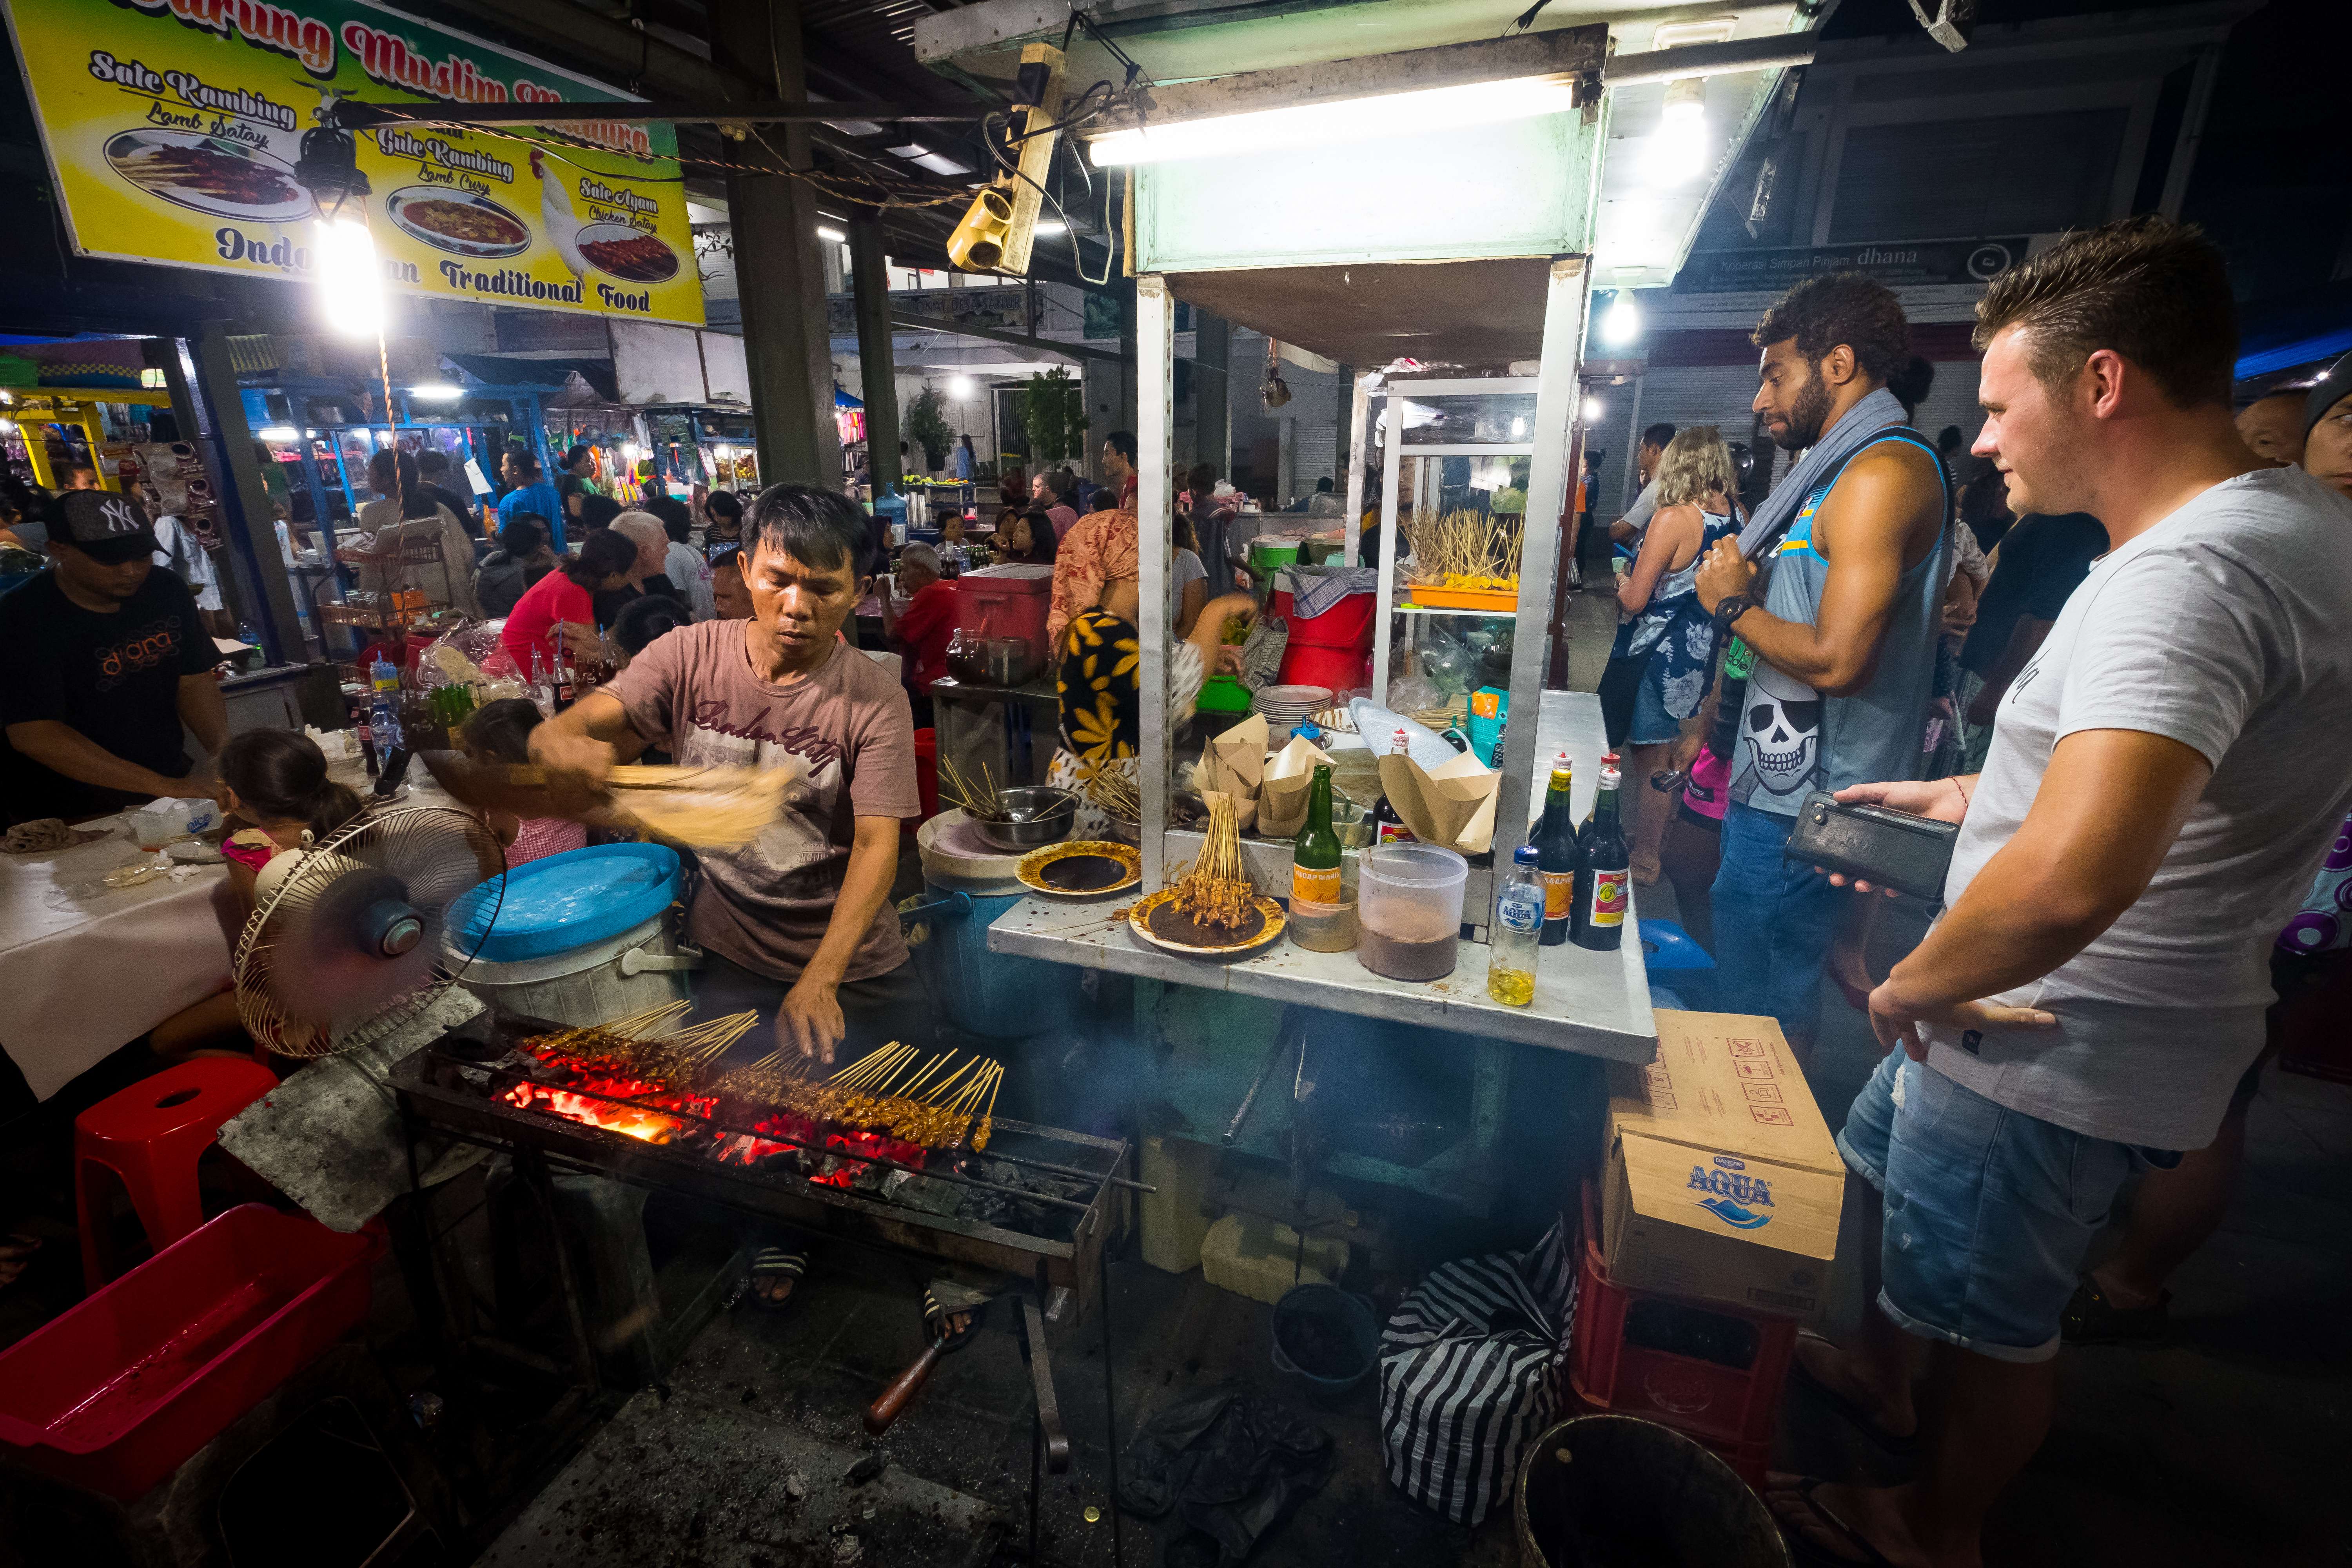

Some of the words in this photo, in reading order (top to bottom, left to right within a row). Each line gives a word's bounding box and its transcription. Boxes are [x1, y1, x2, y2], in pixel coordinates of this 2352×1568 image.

[87, 50, 165, 94] Sate
[341, 20, 508, 103] Muslim
[145, 101, 204, 130] Lamb
[210, 115, 269, 149] Satay
[376, 127, 426, 158] Gule
[417, 162, 455, 184] Lamb
[579, 177, 614, 203] Sate
[614, 188, 659, 214] Ayam
[589, 205, 627, 223] Chicken
[629, 213, 658, 234] Satay
[1721, 259, 1767, 271] Koperasi
[1769, 256, 1810, 270] Simpan
[1812, 255, 1850, 268] Pinjam
[1857, 247, 1918, 265] dhana
[439, 260, 584, 304] Traditional
[597, 283, 652, 312] Food
[982, 295, 1021, 310] SANUR
[1503, 906, 1532, 920] AQUA
[1716, 1158, 1743, 1167] DANONE
[1686, 1165, 1775, 1207] AQUA
